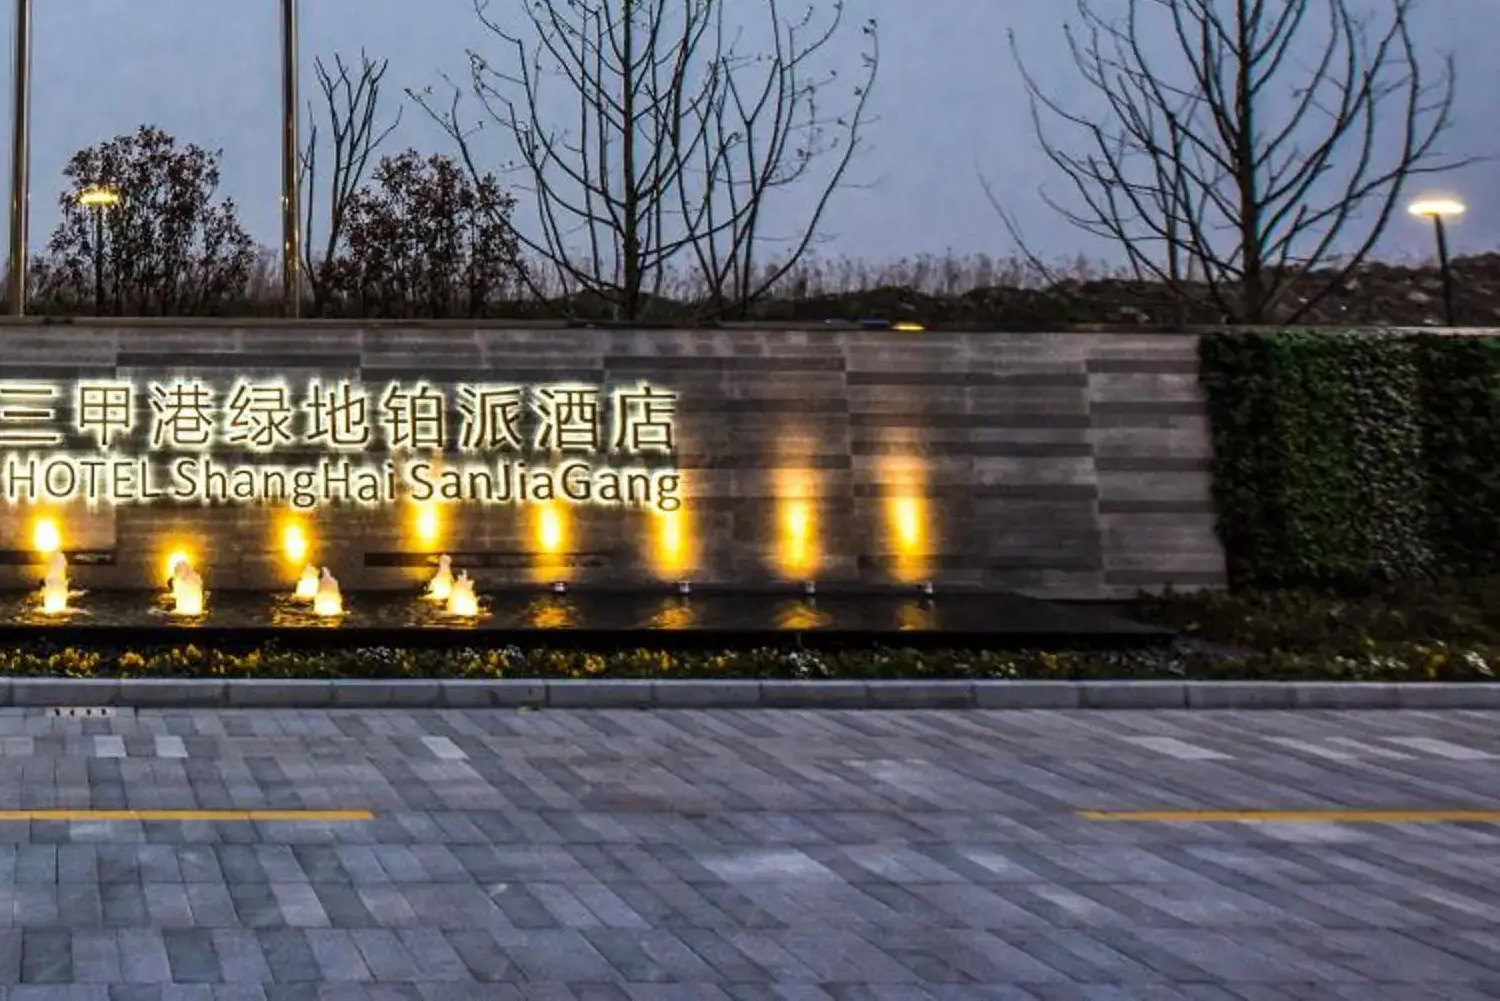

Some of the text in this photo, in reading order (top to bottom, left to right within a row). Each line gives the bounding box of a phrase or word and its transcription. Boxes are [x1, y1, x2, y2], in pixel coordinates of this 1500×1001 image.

[8, 460, 162, 499] HOTEL
[174, 459, 396, 507] ShangHai
[410, 462, 681, 512] SanJiaGang
